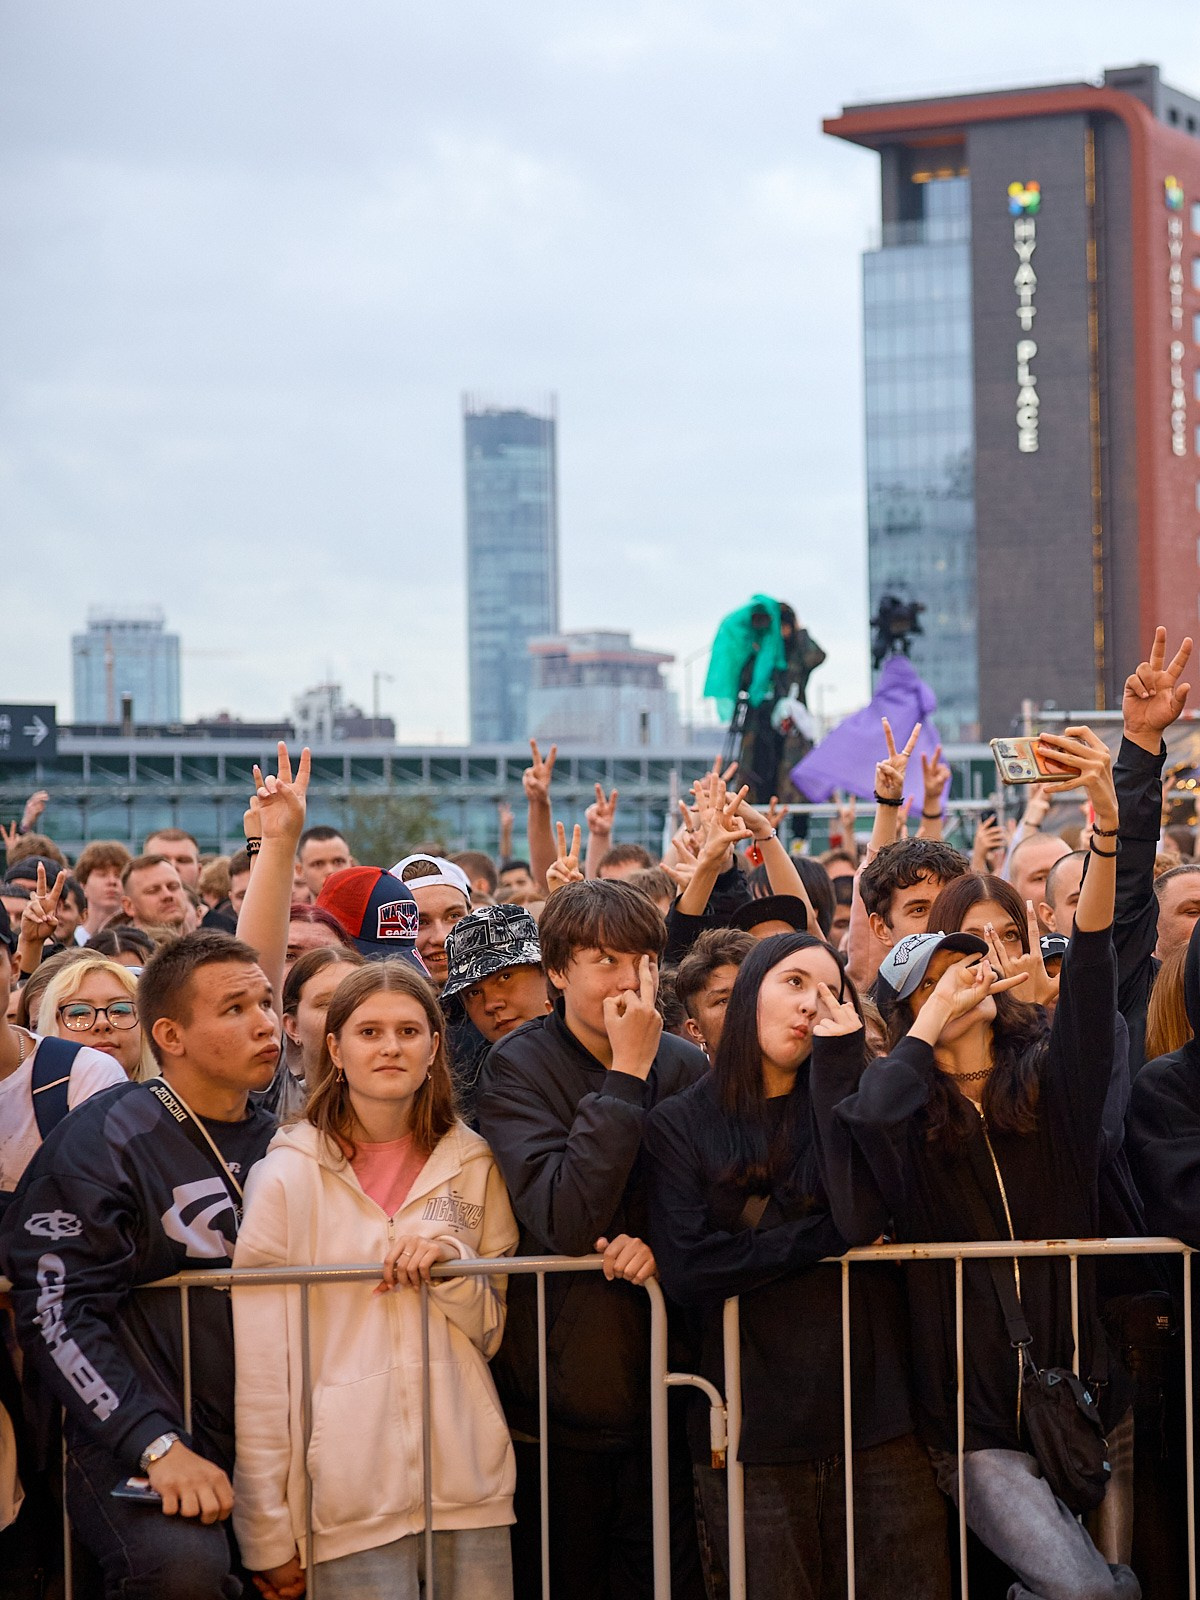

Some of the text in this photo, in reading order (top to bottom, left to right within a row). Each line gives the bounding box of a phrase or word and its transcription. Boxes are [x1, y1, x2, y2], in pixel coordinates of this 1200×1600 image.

[1014, 218, 1039, 452] HYATT PLACE
[1167, 216, 1187, 456] HYATT PLACE
